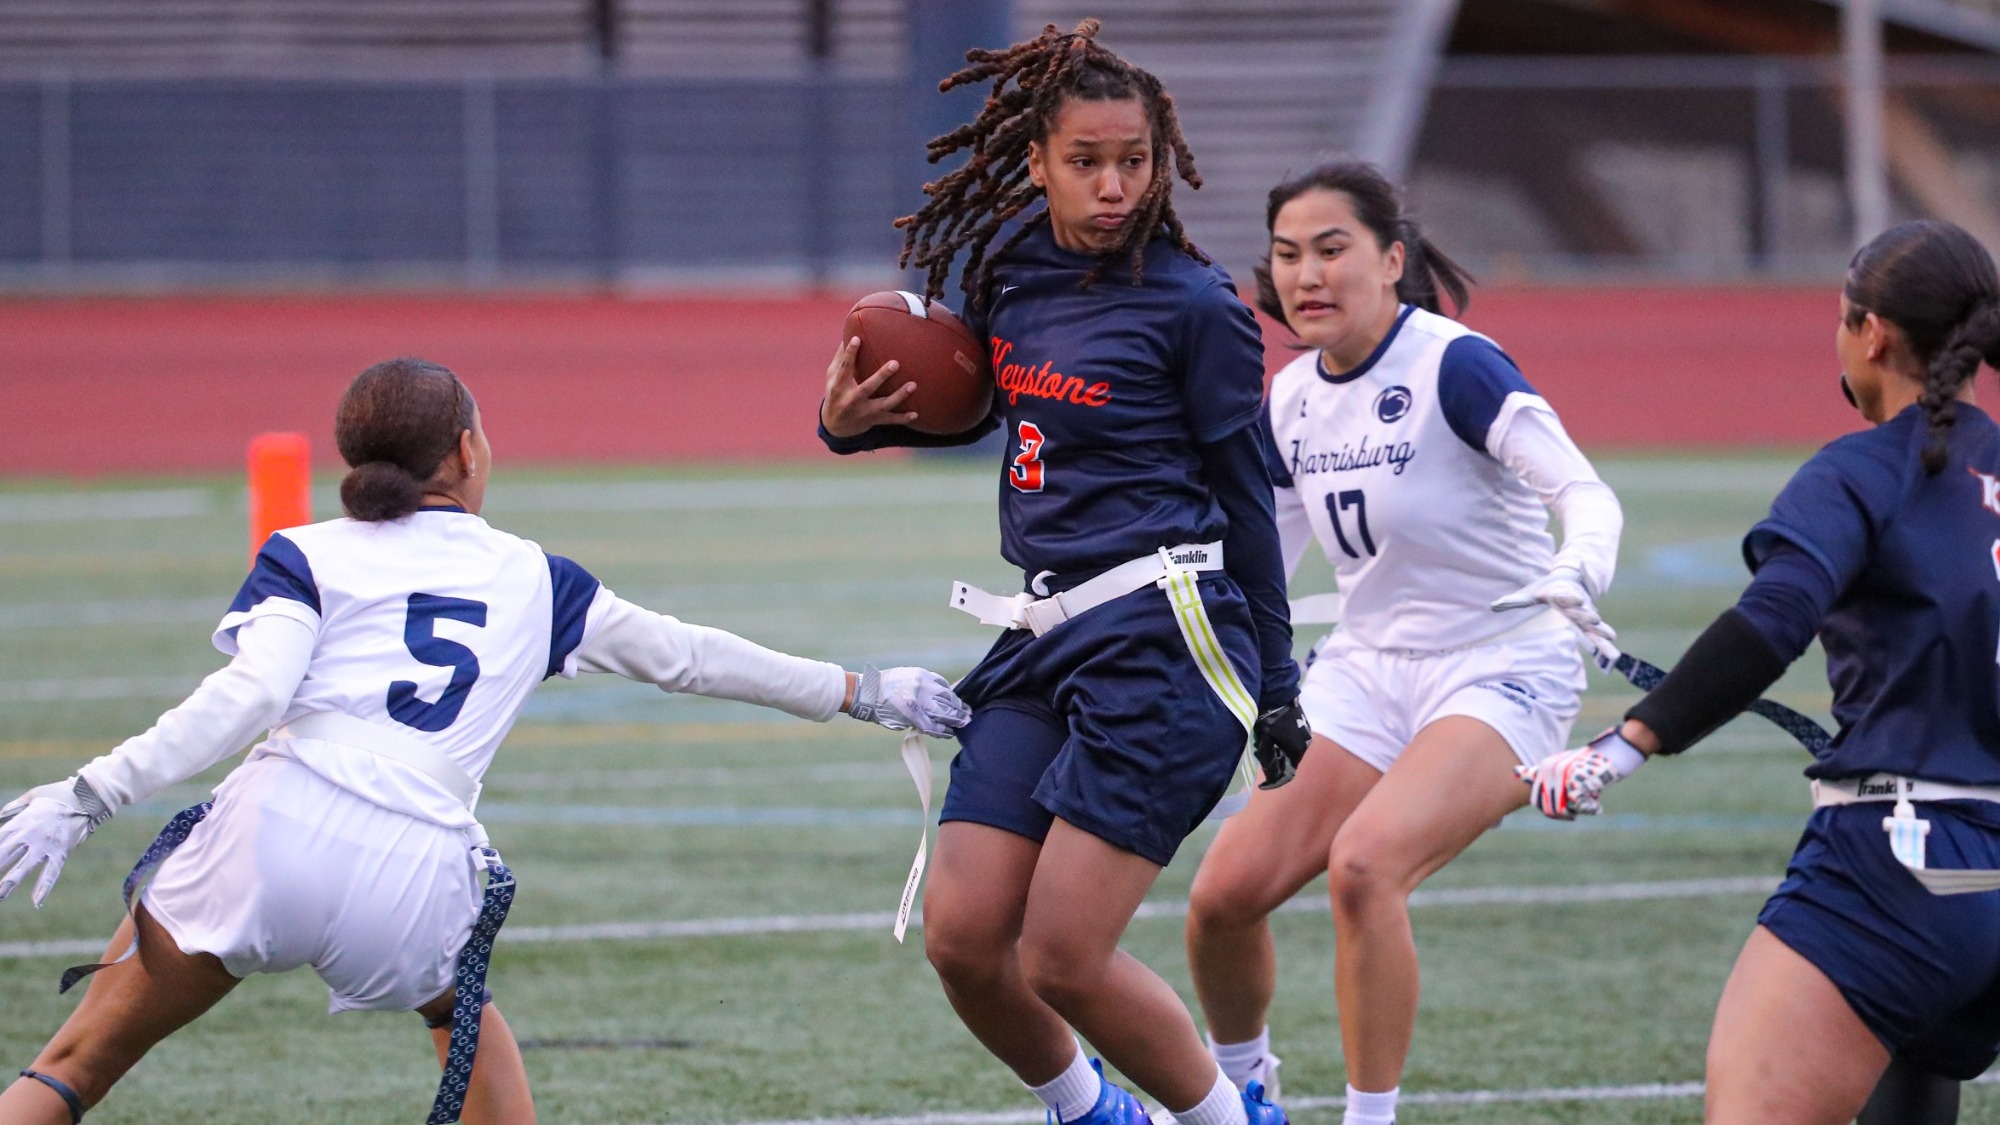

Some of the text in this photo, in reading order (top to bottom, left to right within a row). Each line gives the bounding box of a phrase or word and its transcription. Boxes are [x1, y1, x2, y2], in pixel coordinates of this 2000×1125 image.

[1010, 420, 1045, 493] 3
[1291, 435, 1416, 476] Harrisburg
[1325, 489, 1377, 559] 17
[1167, 550, 1208, 565] anklin
[386, 592, 488, 733] 5
[1857, 776, 1914, 797] Frankn
